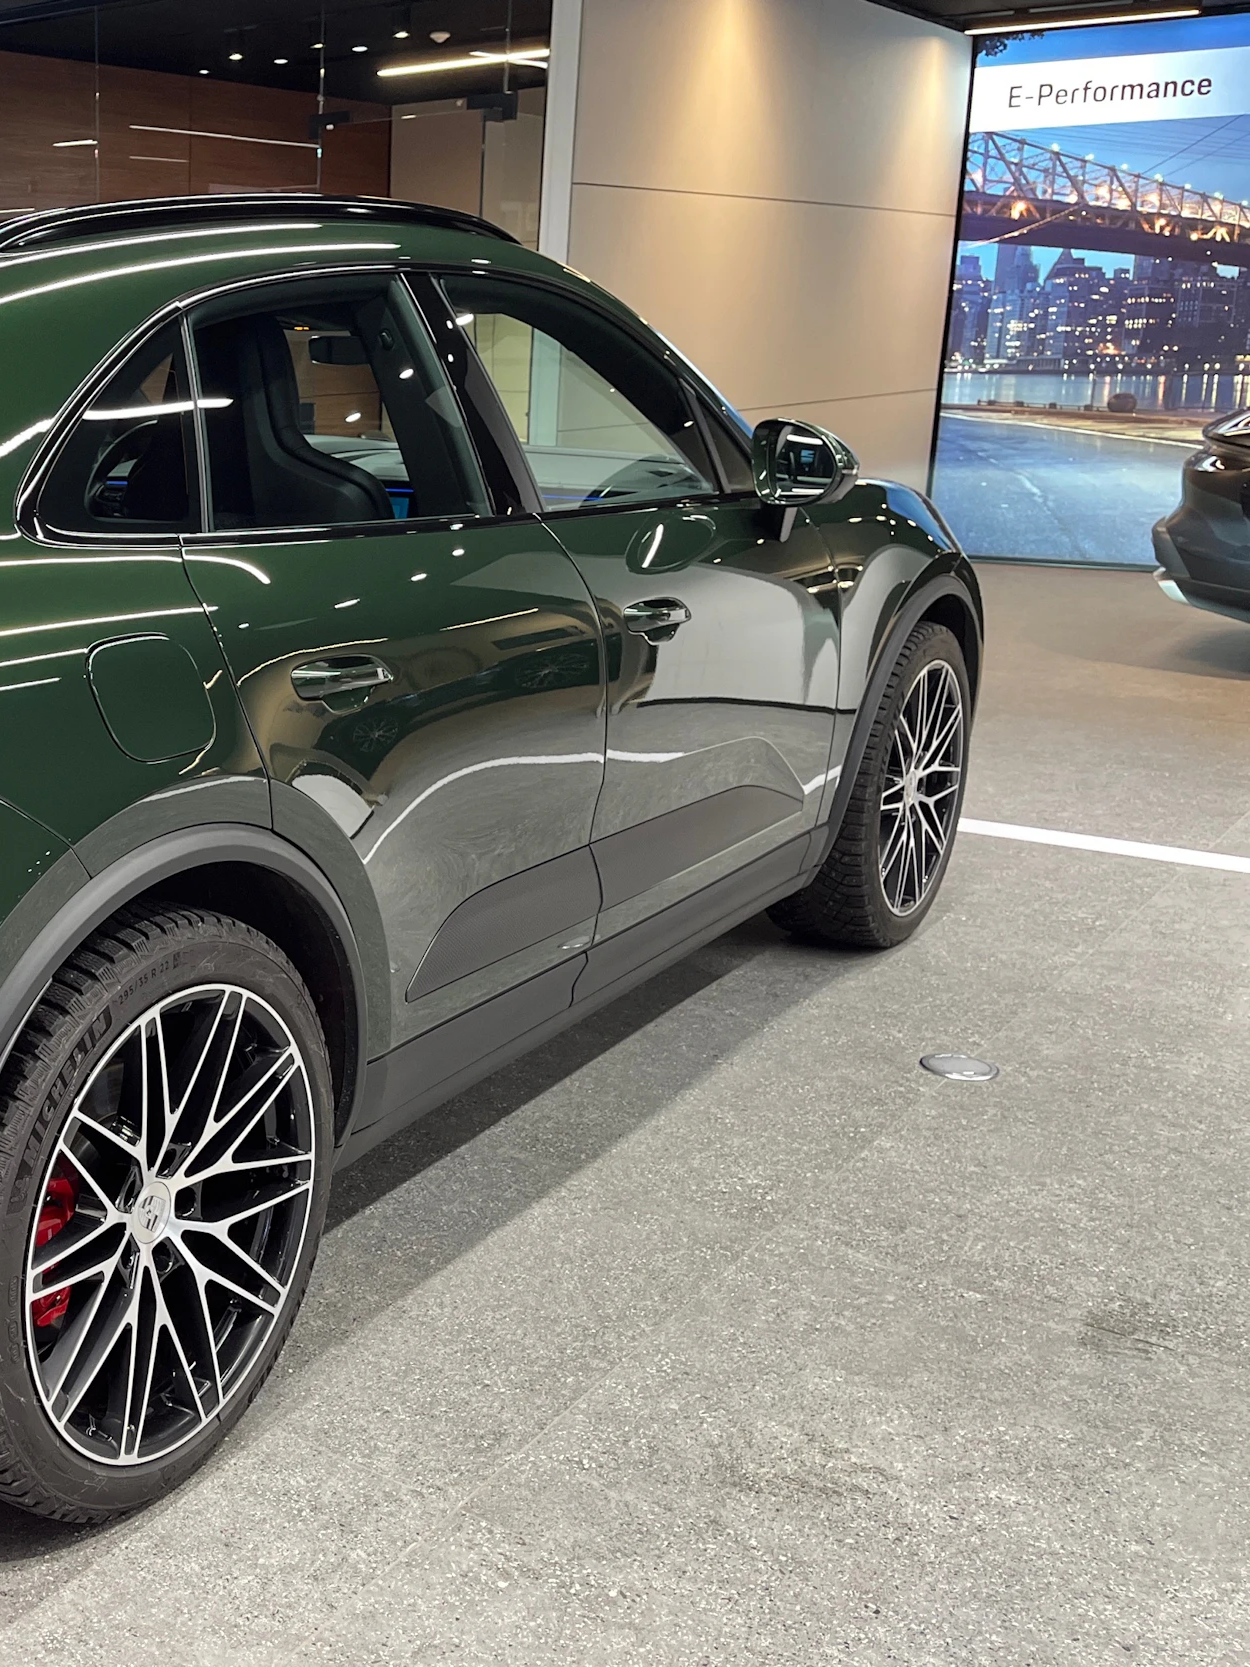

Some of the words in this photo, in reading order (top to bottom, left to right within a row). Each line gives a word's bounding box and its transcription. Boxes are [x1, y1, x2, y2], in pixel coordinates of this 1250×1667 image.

[1008, 77, 1213, 109] E-Performance
[118, 972, 149, 1005] 295/35
[23, 1008, 110, 1168] MICHELIN
